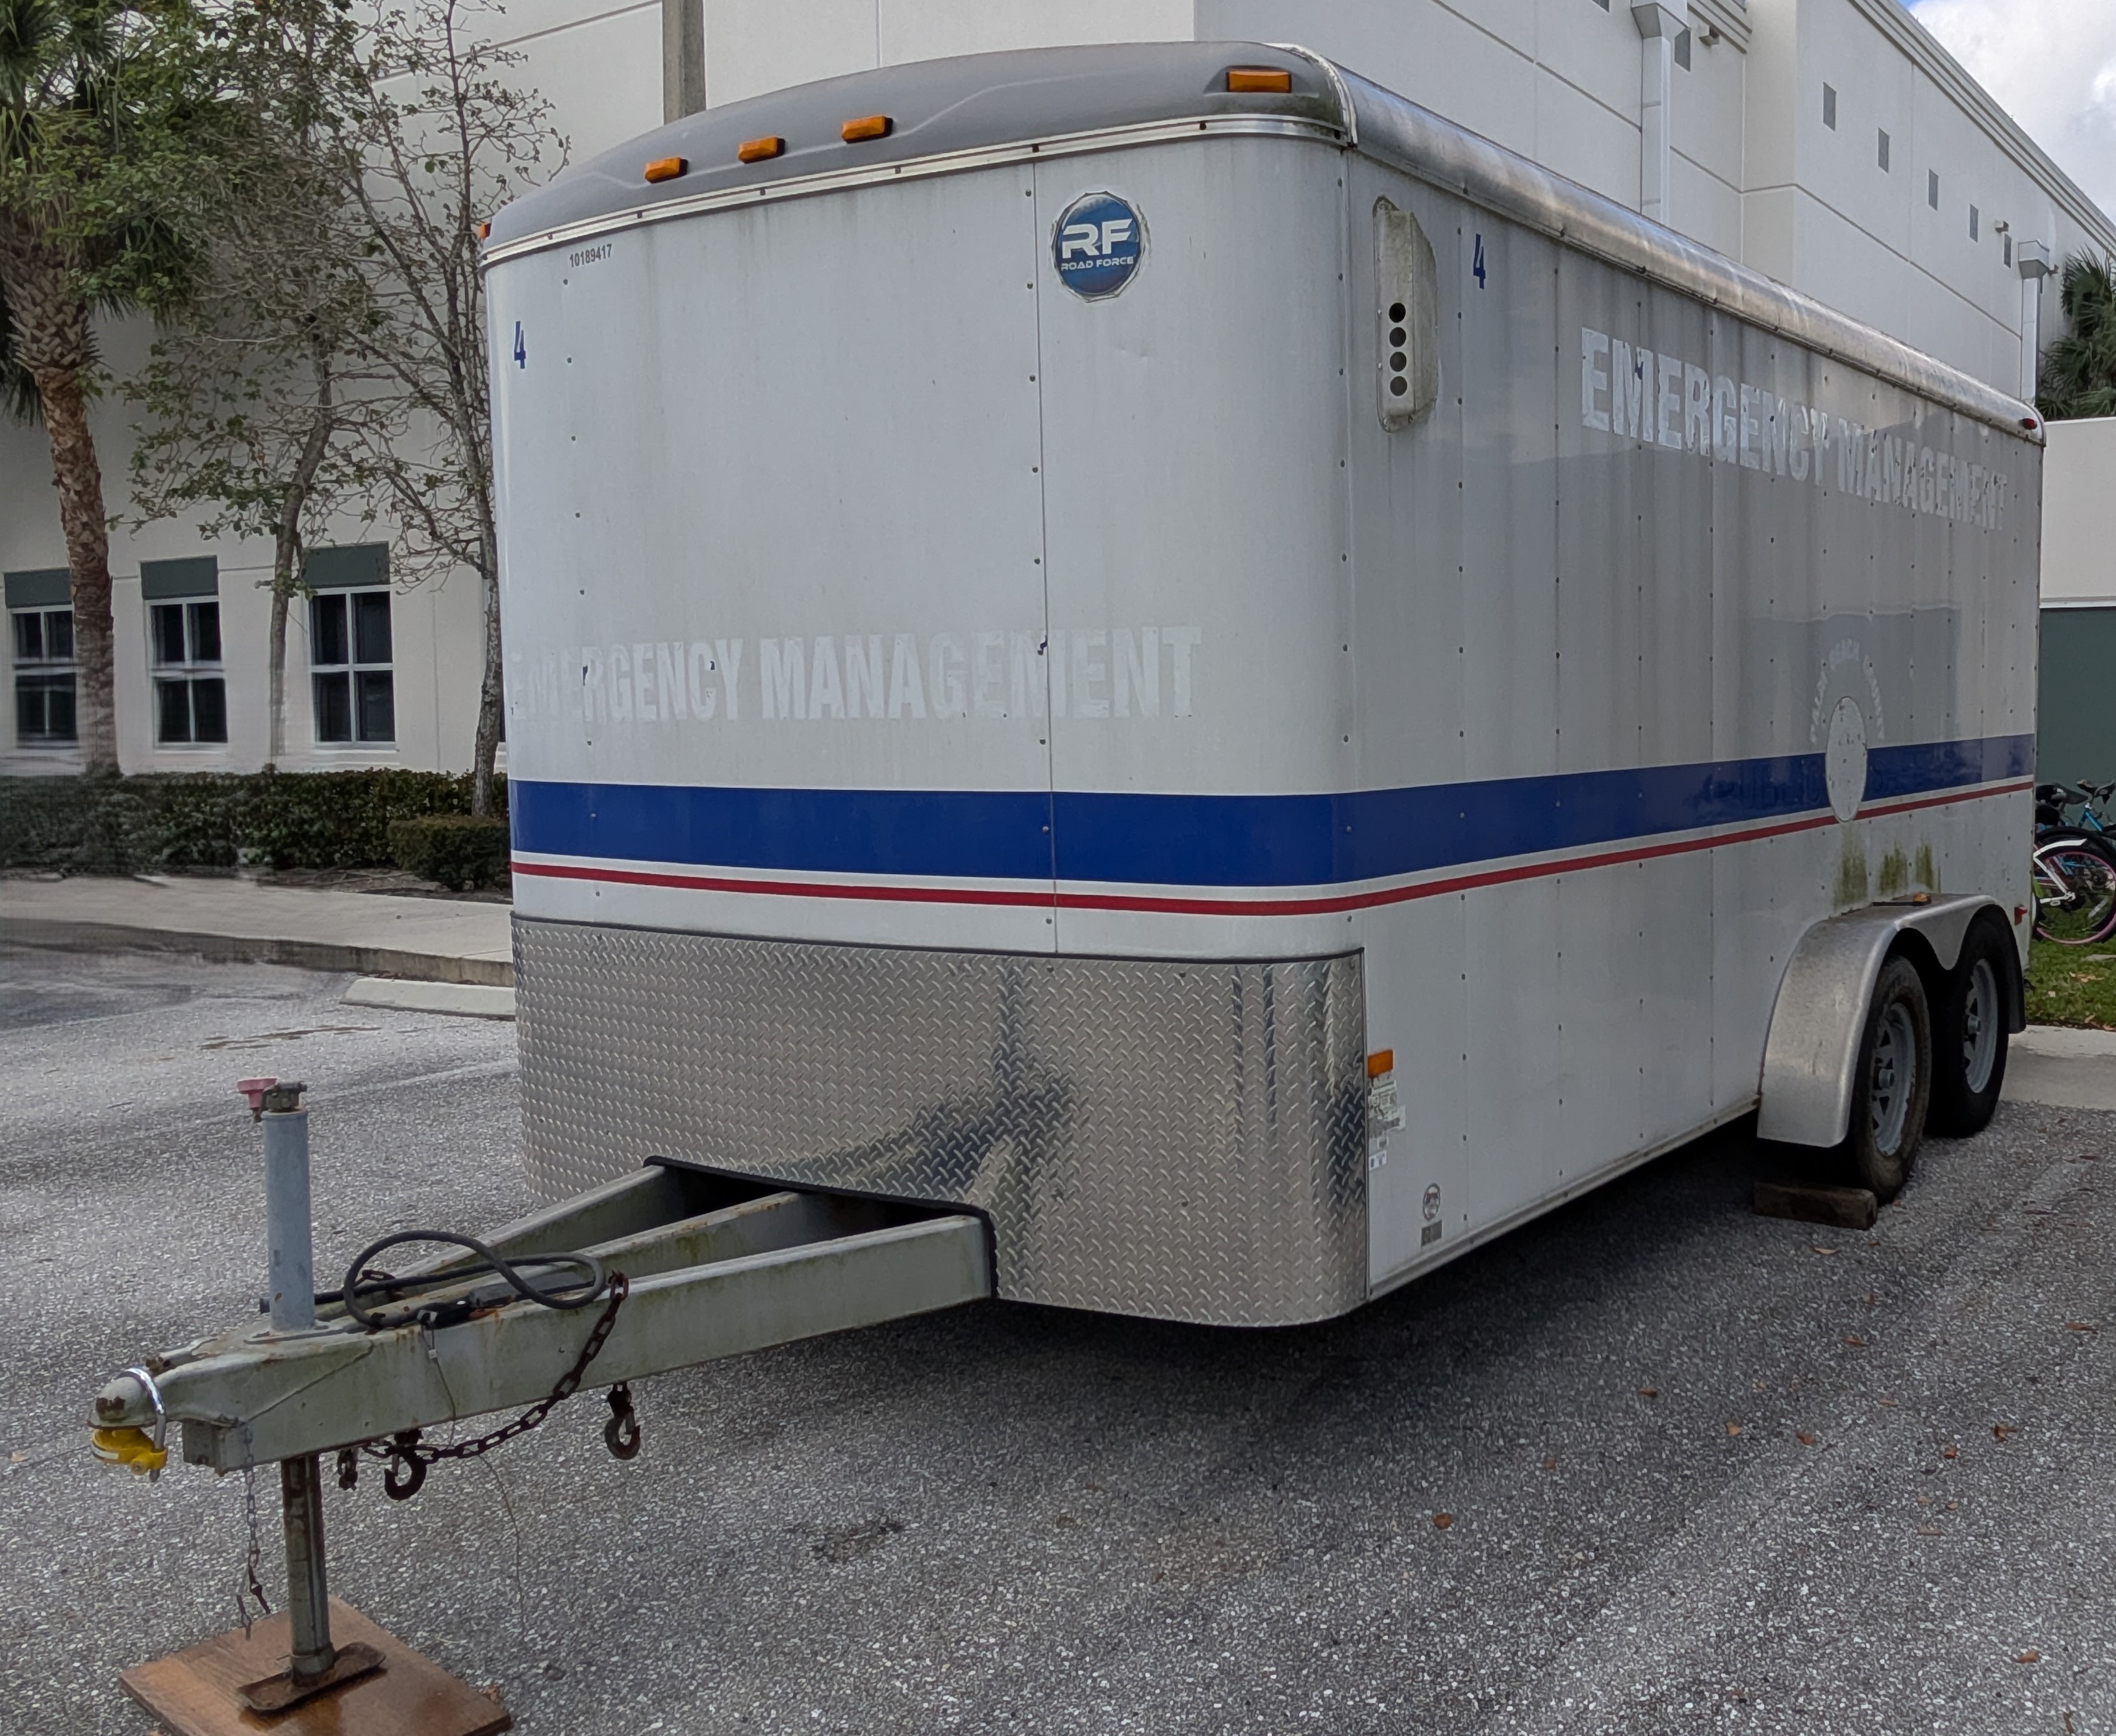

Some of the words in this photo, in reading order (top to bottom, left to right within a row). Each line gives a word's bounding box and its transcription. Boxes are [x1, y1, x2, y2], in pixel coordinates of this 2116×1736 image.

[570, 244, 612, 268] 10189417
[1062, 218, 1133, 259] RF
[1473, 234, 1485, 290] 4
[1061, 261, 1094, 271] ROAD
[1096, 256, 1134, 268] FORCE
[514, 321, 526, 369] 4
[1581, 327, 1828, 485] EMERGENCY
[1838, 417, 2008, 531] MANAGEMENT
[510, 637, 744, 723] EMERGENCY
[760, 625, 1202, 721] MANAGEMENT
